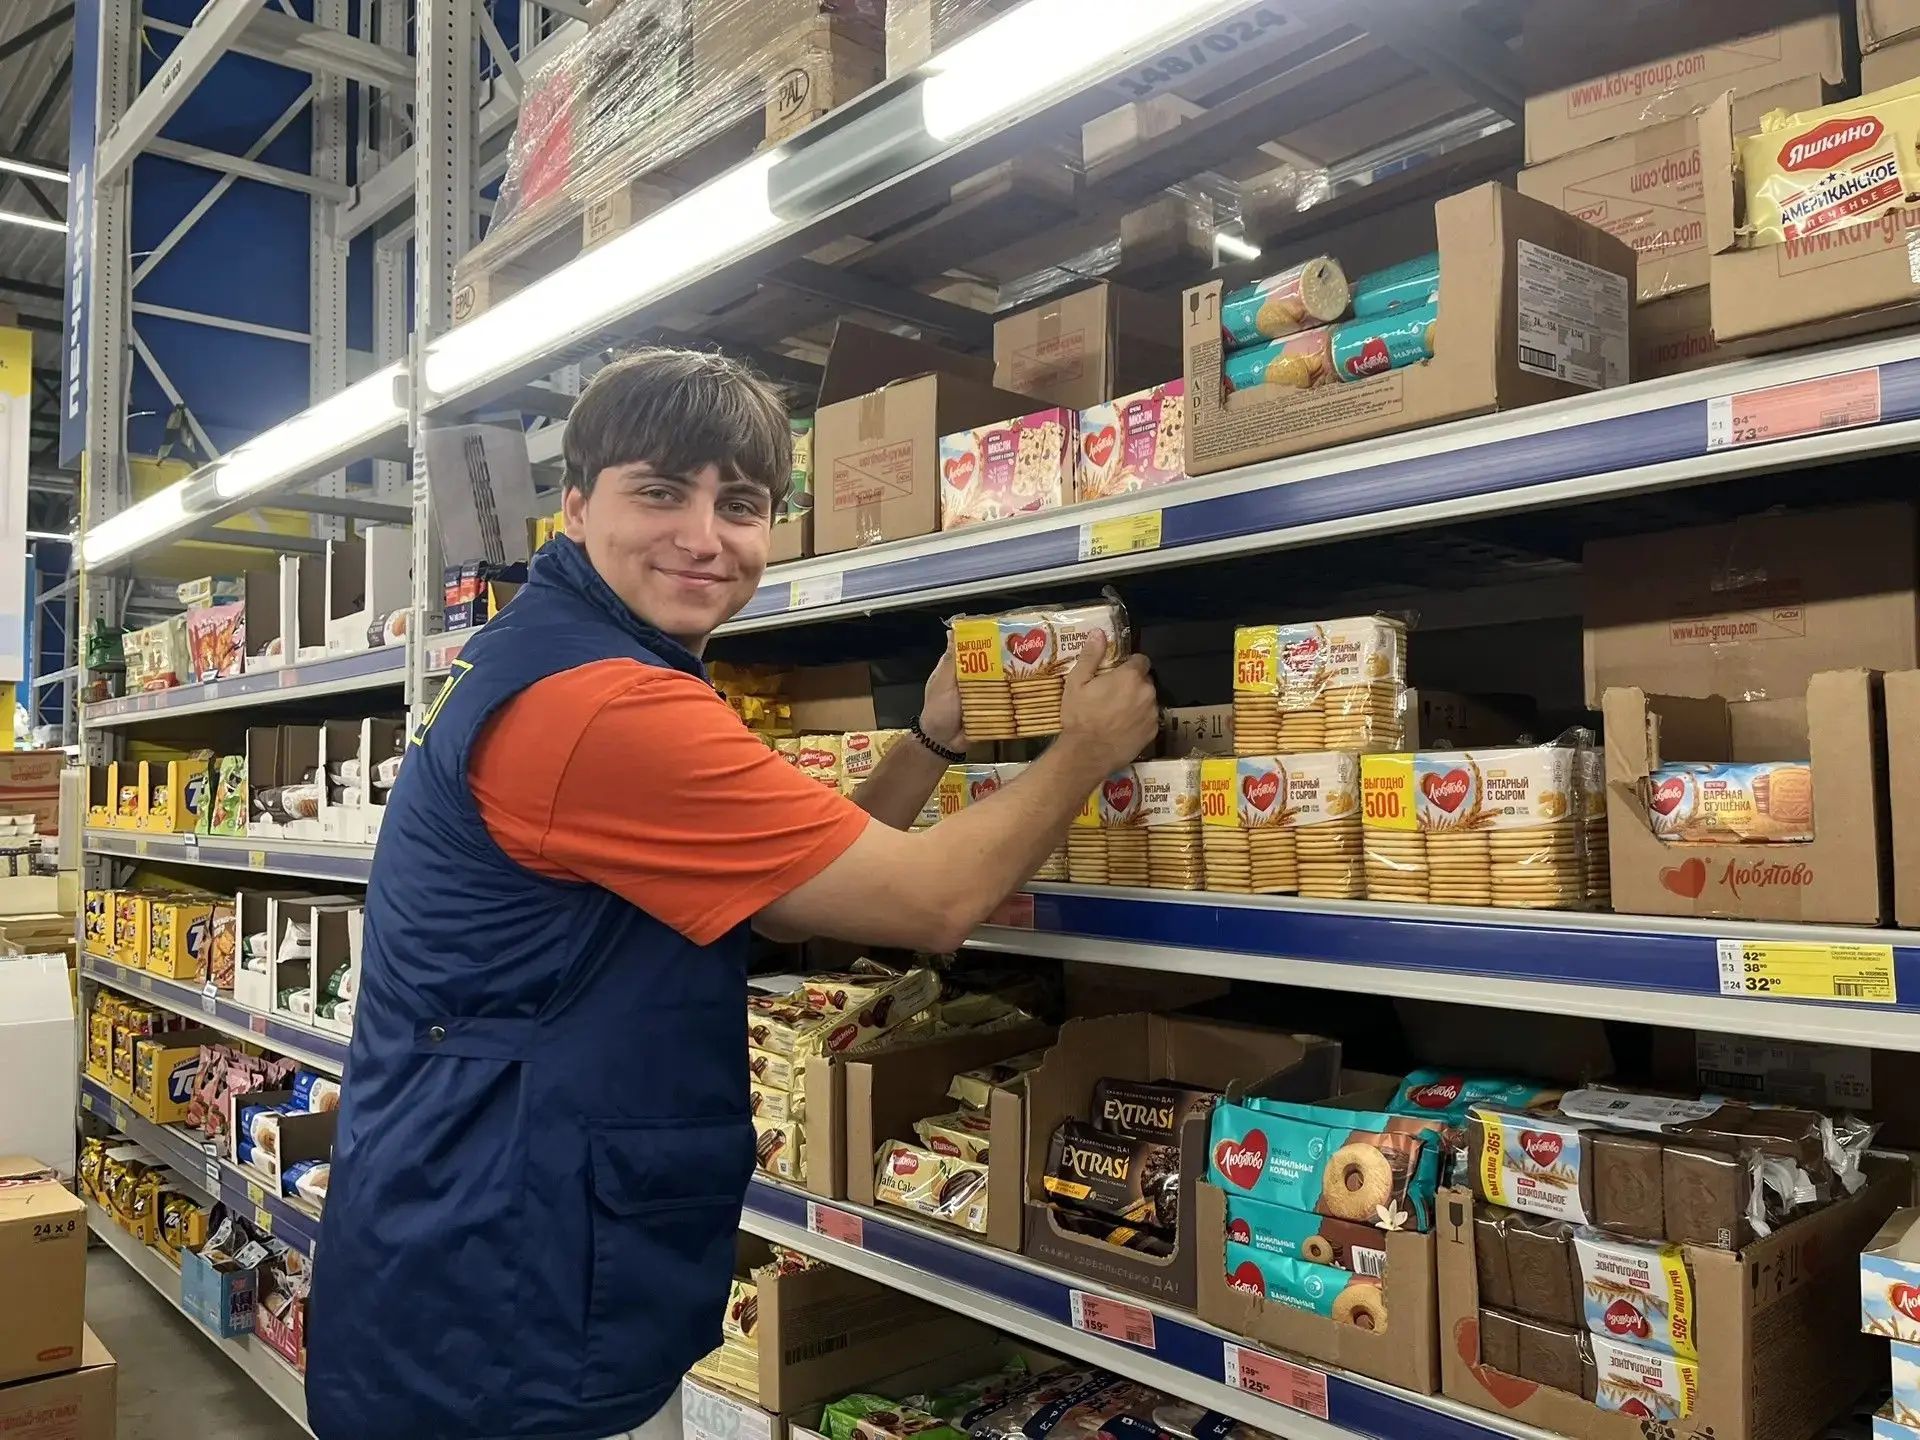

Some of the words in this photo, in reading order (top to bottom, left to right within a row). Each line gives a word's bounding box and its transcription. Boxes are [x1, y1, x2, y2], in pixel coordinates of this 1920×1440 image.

[1572, 53, 1706, 108] www.kdv-group.com
[779, 76, 803, 112] PAL
[1781, 160, 1899, 226] АМЕРИКАНСКОЕ
[1577, 206, 1604, 221] DV
[1807, 190, 1880, 229] ПЕЧЕНЬЕ
[68, 163, 87, 420] ПЕЧЕНЬЕ
[1060, 632, 1090, 643] ЯНТАРНЫ
[1672, 622, 1757, 640] www.kdv-group.com
[957, 638, 992, 651] ВЫГОДНО
[1012, 636, 1044, 658] Любятово
[1067, 641, 1086, 651] СЫР
[960, 651, 989, 674] 500
[1335, 653, 1357, 664] СЫРОМ
[1144, 783, 1171, 793] ЯНТАРНЫЙ
[1290, 778, 1320, 790] ЯНТАРНЫЙ
[1364, 776, 1405, 790] ВЫГОДНО
[1429, 778, 1467, 804] Любятово
[1486, 776, 1529, 789] ЯНТАРНЫЙ
[1150, 794, 1168, 803] СЫРОМ
[1248, 782, 1277, 804] Любятово
[1290, 791, 1295, 800] С
[1296, 791, 1317, 800] СЫРОМ
[1487, 791, 1494, 801] С
[1496, 790, 1526, 801] СЫРОМ
[1365, 792, 1399, 818] 500
[1719, 858, 1814, 901] Любятово
[1728, 952, 1732, 960] 1
[1729, 964, 1735, 972] 3
[1730, 981, 1741, 990] 24
[1488, 1132, 1501, 1156] 365
[1220, 1146, 1263, 1177] Любятово
[1270, 1157, 1314, 1173] ВАНИЛЬНЫЕ
[1269, 1166, 1299, 1179] КОЛЬЦА
[1490, 1155, 1500, 1197] ВЫГОДНО
[1517, 1186, 1566, 1206] ШОКОЛАДНОЕ
[34, 1223, 51, 1237] 24
[56, 1224, 63, 1233] x
[67, 1220, 75, 1231] 8
[1594, 1260, 1649, 1281] ШОКОЛАДНОЕ
[1151, 1276, 1179, 1294] ДА!
[1669, 1270, 1685, 1314] ВЫГОДНО
[1672, 1312, 1687, 1341] 365
[1610, 1356, 1662, 1378] ШОКОЛАДНОЕ
